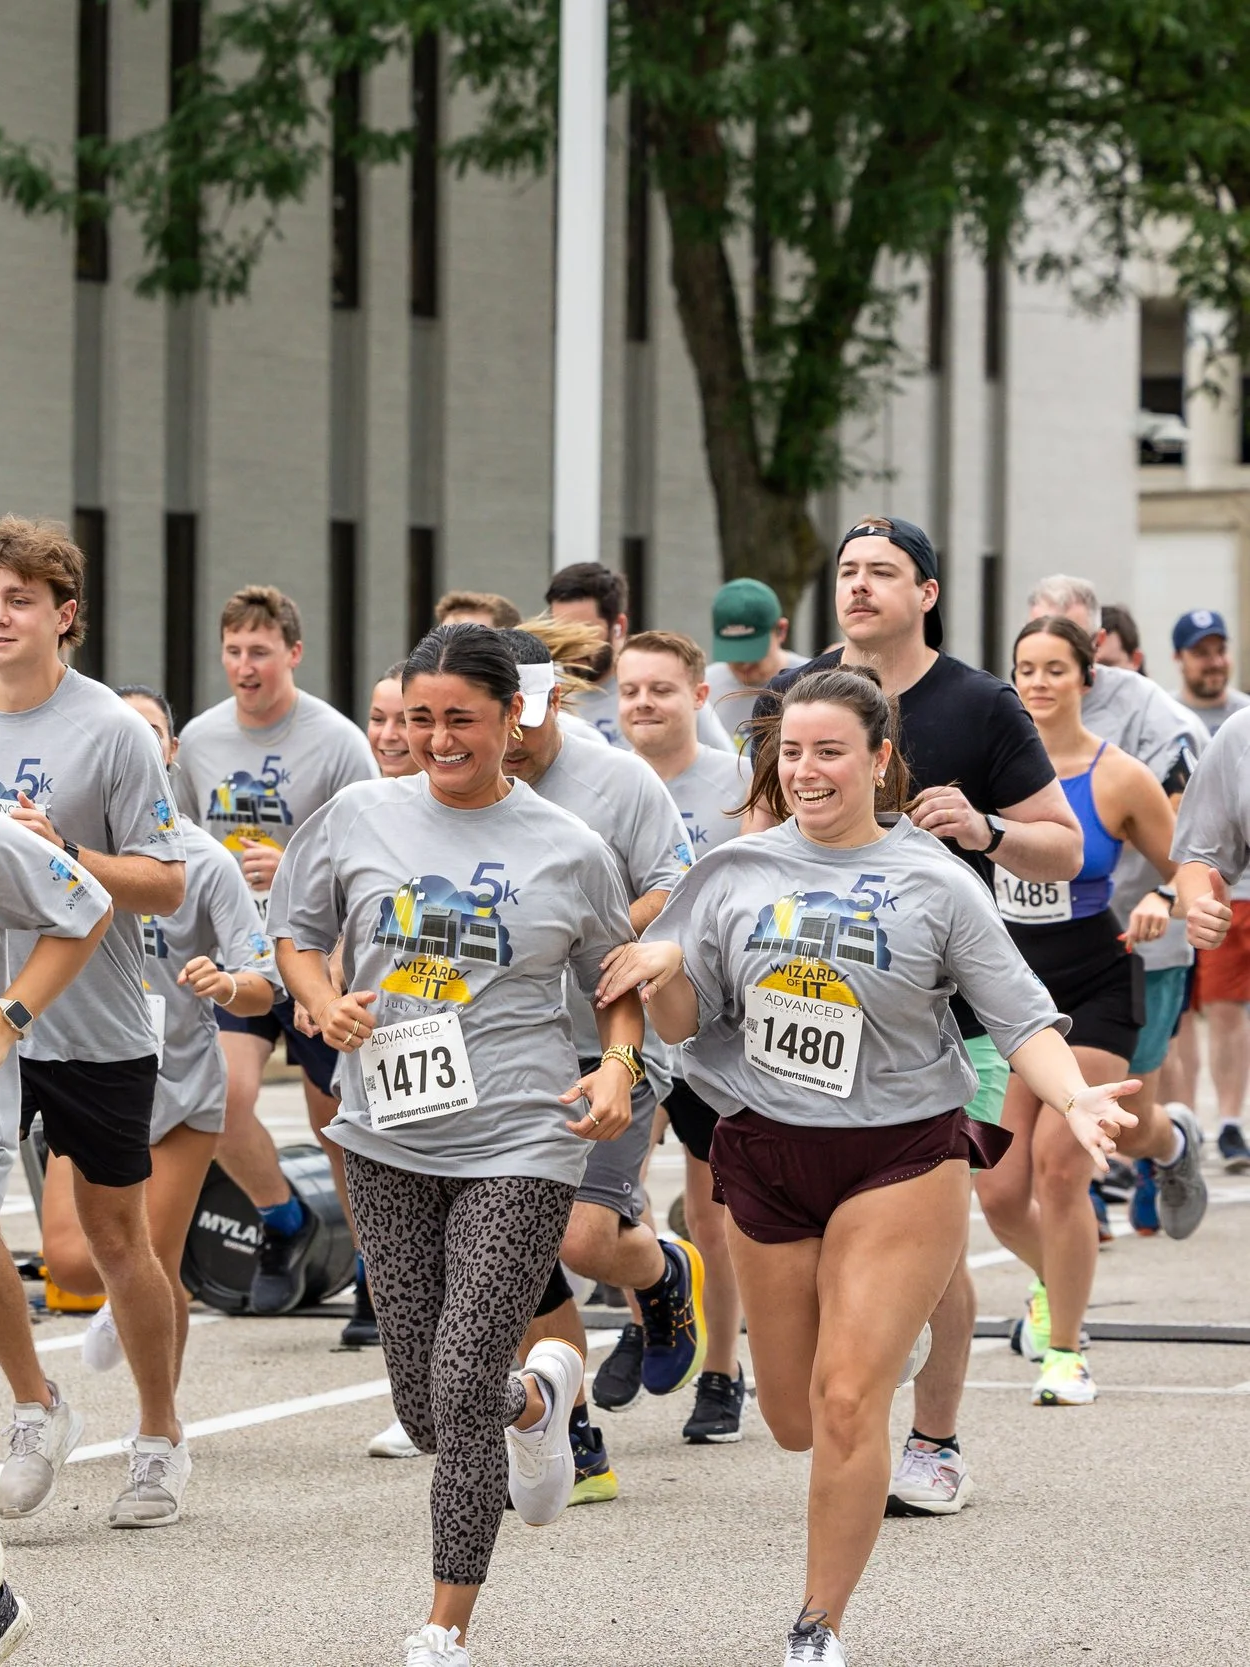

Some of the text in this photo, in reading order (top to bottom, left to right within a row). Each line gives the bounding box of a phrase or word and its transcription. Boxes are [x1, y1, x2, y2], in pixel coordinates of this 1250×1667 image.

[1003, 878, 1059, 907] 1485
[393, 958, 472, 981] WIZARDS
[424, 953, 445, 965] THE
[799, 956, 820, 967] THE
[769, 962, 850, 983] WIZARDS
[410, 975, 447, 1000] OF IT
[786, 978, 827, 1000] OF IT
[385, 999, 411, 1012] July
[764, 992, 844, 1019] ADVANCED
[371, 1021, 440, 1047] ADVANCED
[763, 1016, 845, 1070] 1480
[377, 1046, 456, 1101] 1473
[751, 1054, 843, 1092] advancedsportstiming.com
[377, 1097, 469, 1125] advancedsportstiming.com
